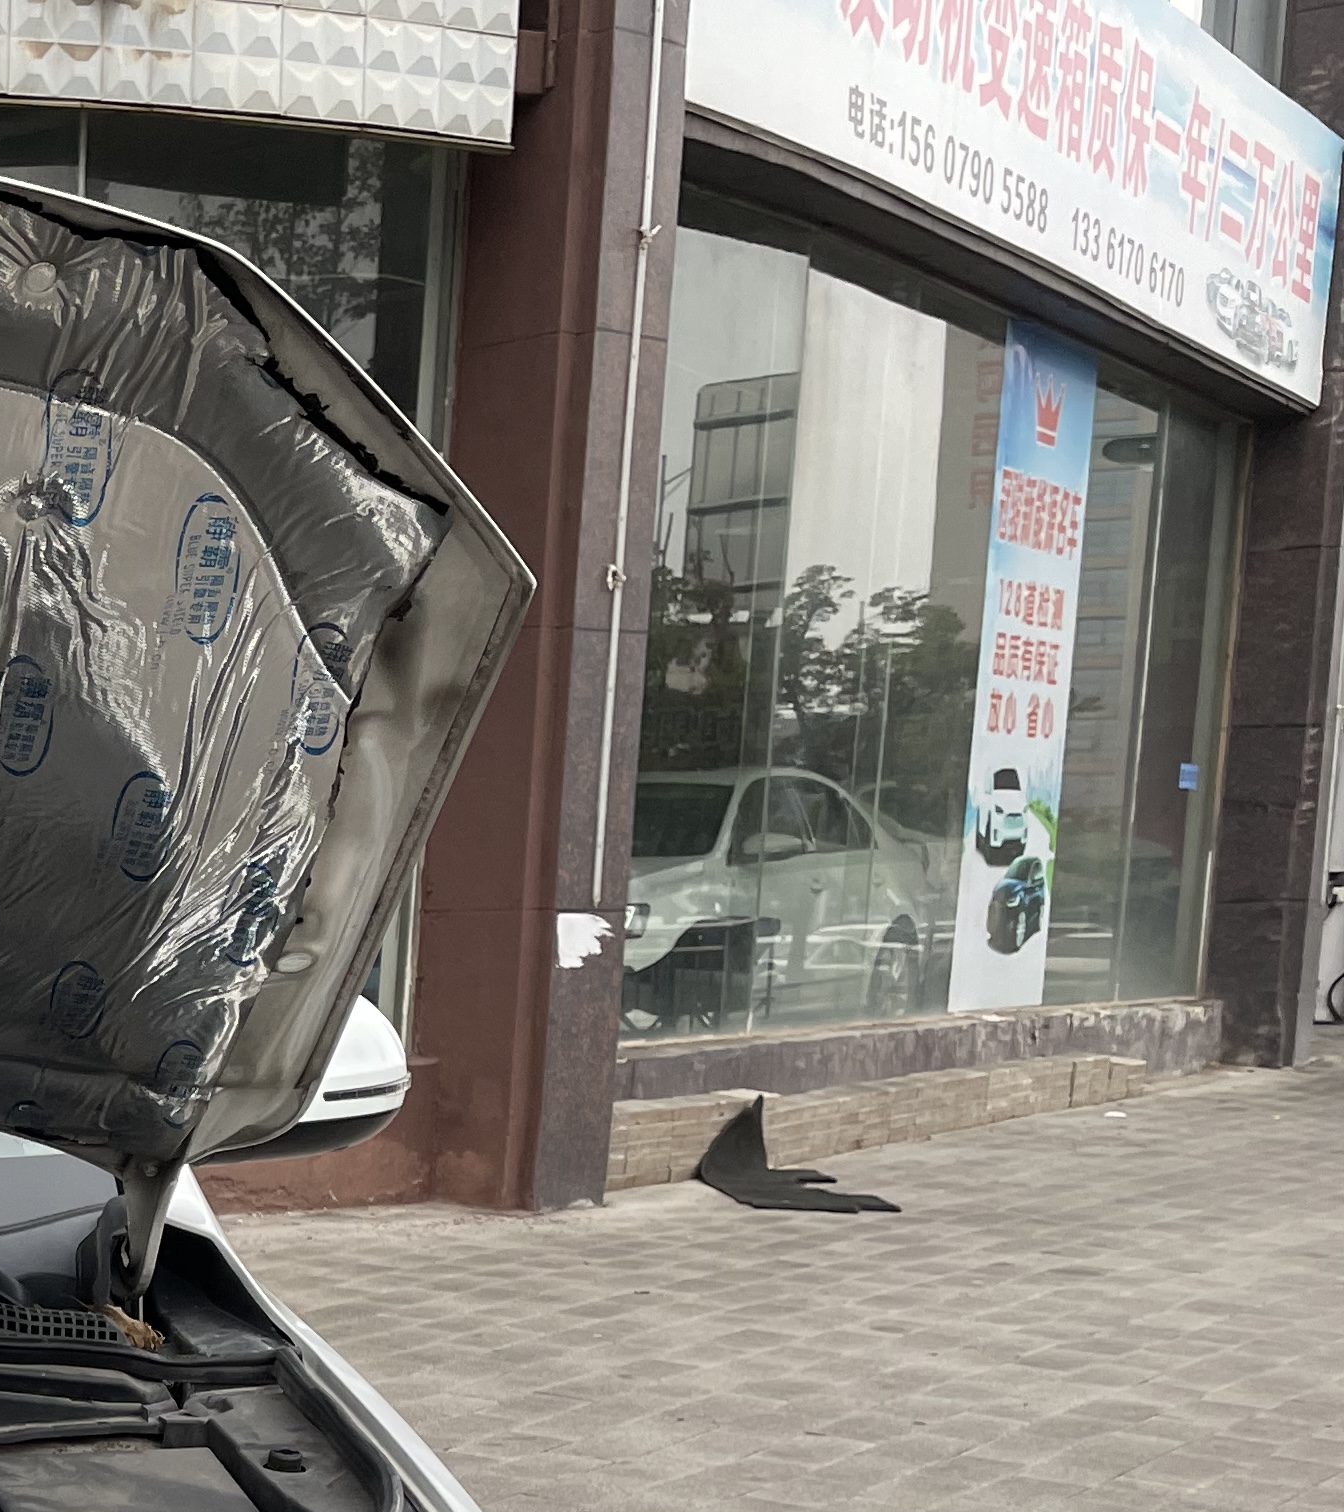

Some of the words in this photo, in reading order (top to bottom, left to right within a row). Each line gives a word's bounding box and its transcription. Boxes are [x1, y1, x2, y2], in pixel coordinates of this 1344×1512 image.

[848, 84, 936, 174] 电话:156
[943, 135, 995, 206] 0790
[1000, 167, 1049, 234] 5588
[1071, 207, 1101, 262] 133
[1106, 226, 1144, 286] 6170
[1149, 251, 1185, 308] 6170
[999, 578, 1065, 631] 128道检测
[992, 632, 1061, 685] 品质有保证
[986, 688, 1017, 734] 放心
[1026, 692, 1055, 740] 省心
